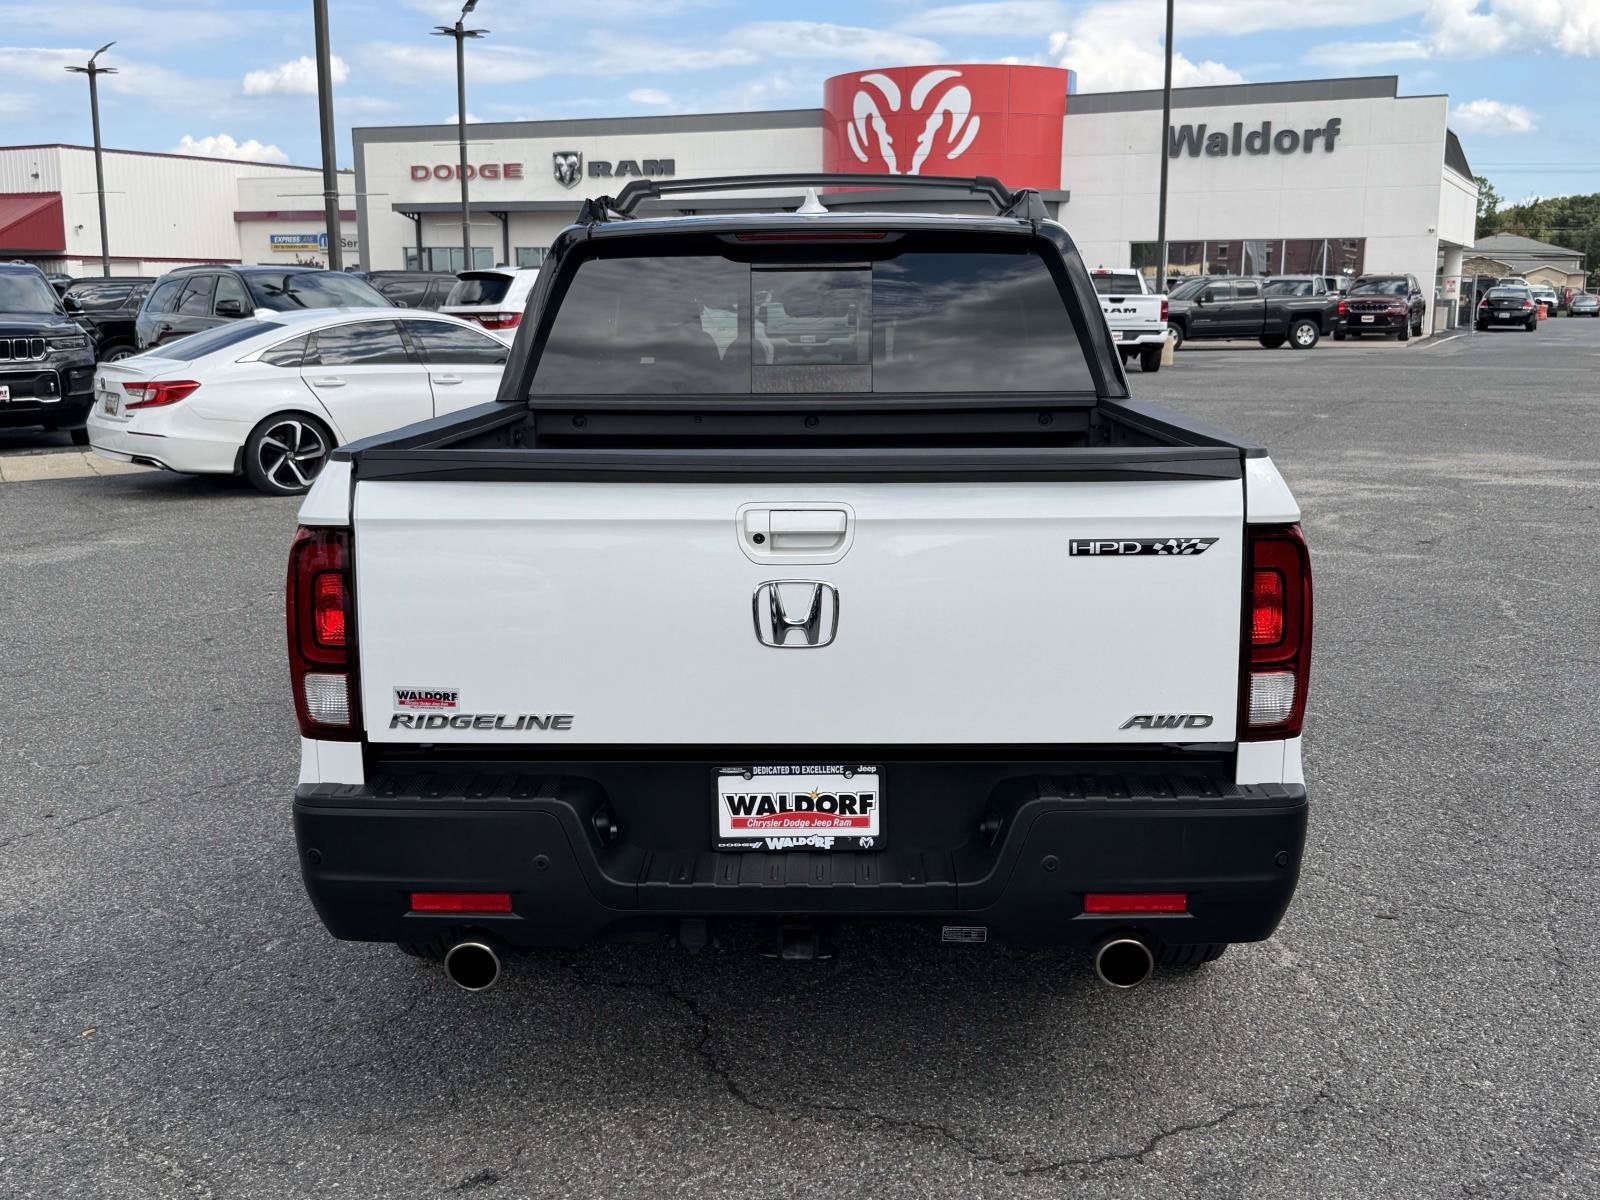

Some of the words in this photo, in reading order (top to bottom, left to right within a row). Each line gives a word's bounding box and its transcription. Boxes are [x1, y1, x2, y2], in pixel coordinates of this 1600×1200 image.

[1169, 117, 1342, 159] Waldorf
[411, 163, 523, 181] DODGE
[588, 159, 675, 178] RAM
[274, 236, 301, 244] EXPRESS
[1072, 541, 1142, 554] HPD
[396, 690, 458, 701] WALDORF
[389, 713, 574, 731] RIDGELINE
[1119, 713, 1214, 729] AWD
[753, 766, 790, 775] DEDICATED
[791, 766, 800, 774] TO
[801, 765, 844, 774] EXCELLENCE
[857, 765, 877, 773] Jeep
[724, 793, 874, 816] WALDORF
[747, 818, 782, 828] Chrysler
[783, 819, 810, 828] Dodge
[811, 819, 832, 828] Jeep
[833, 819, 852, 827] Ram
[765, 836, 835, 850] WALDORF
